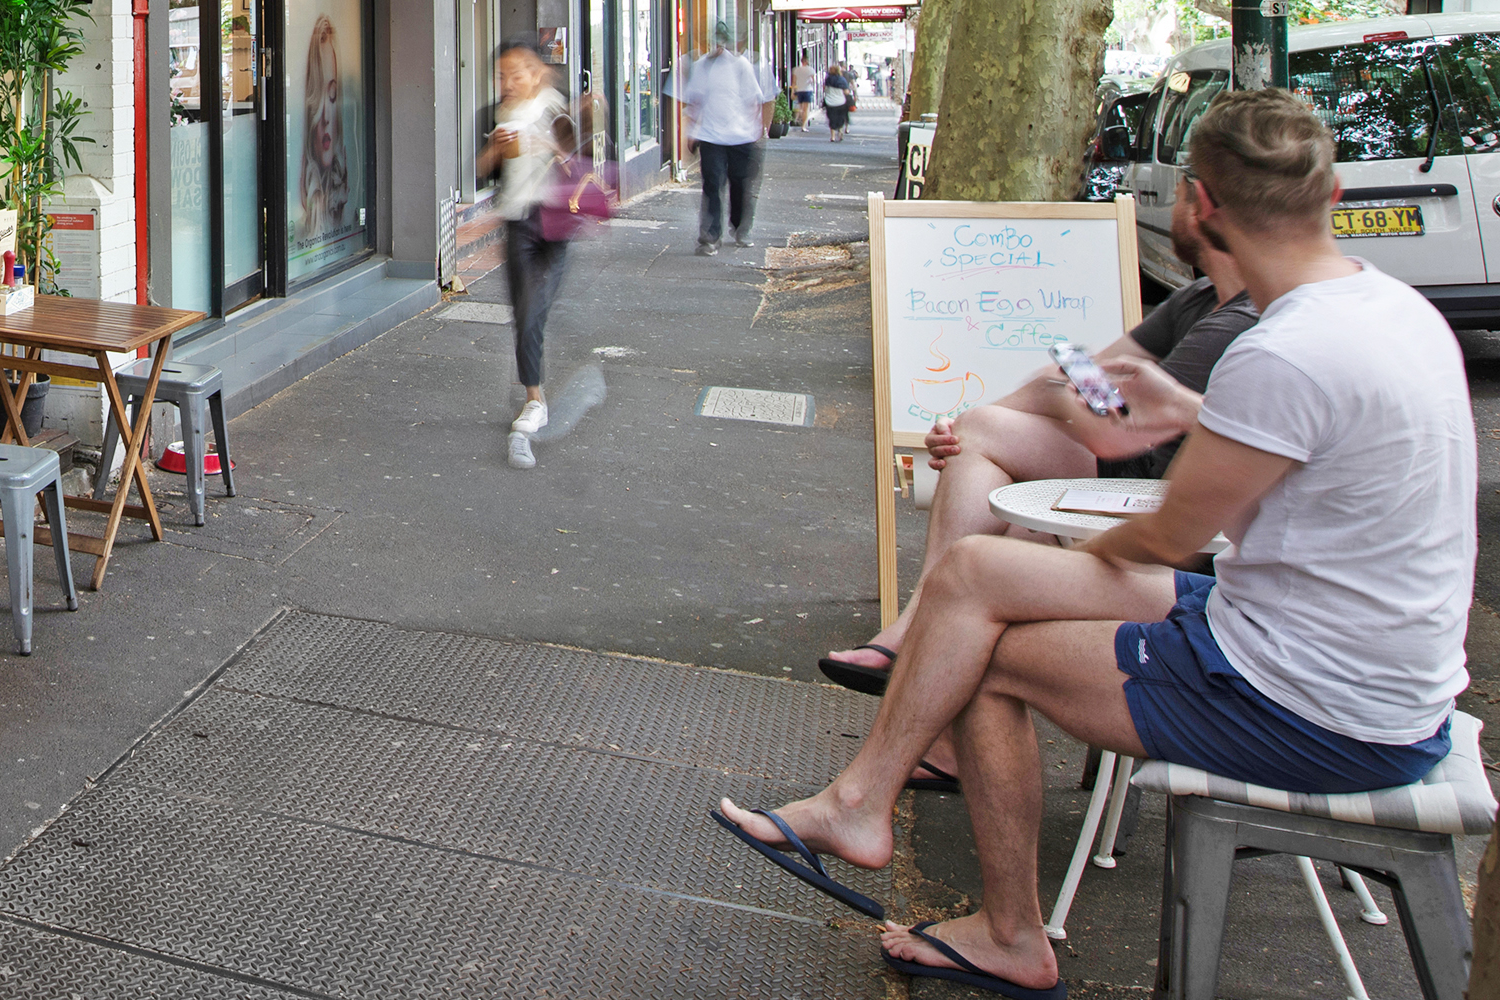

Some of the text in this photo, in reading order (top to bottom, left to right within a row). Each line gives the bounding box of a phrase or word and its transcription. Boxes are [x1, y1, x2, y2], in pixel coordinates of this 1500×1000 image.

[906, 288, 1094, 320] Bacon Egg Wrap
[966, 316, 980, 331] &
[986, 323, 1068, 346] Coffee
